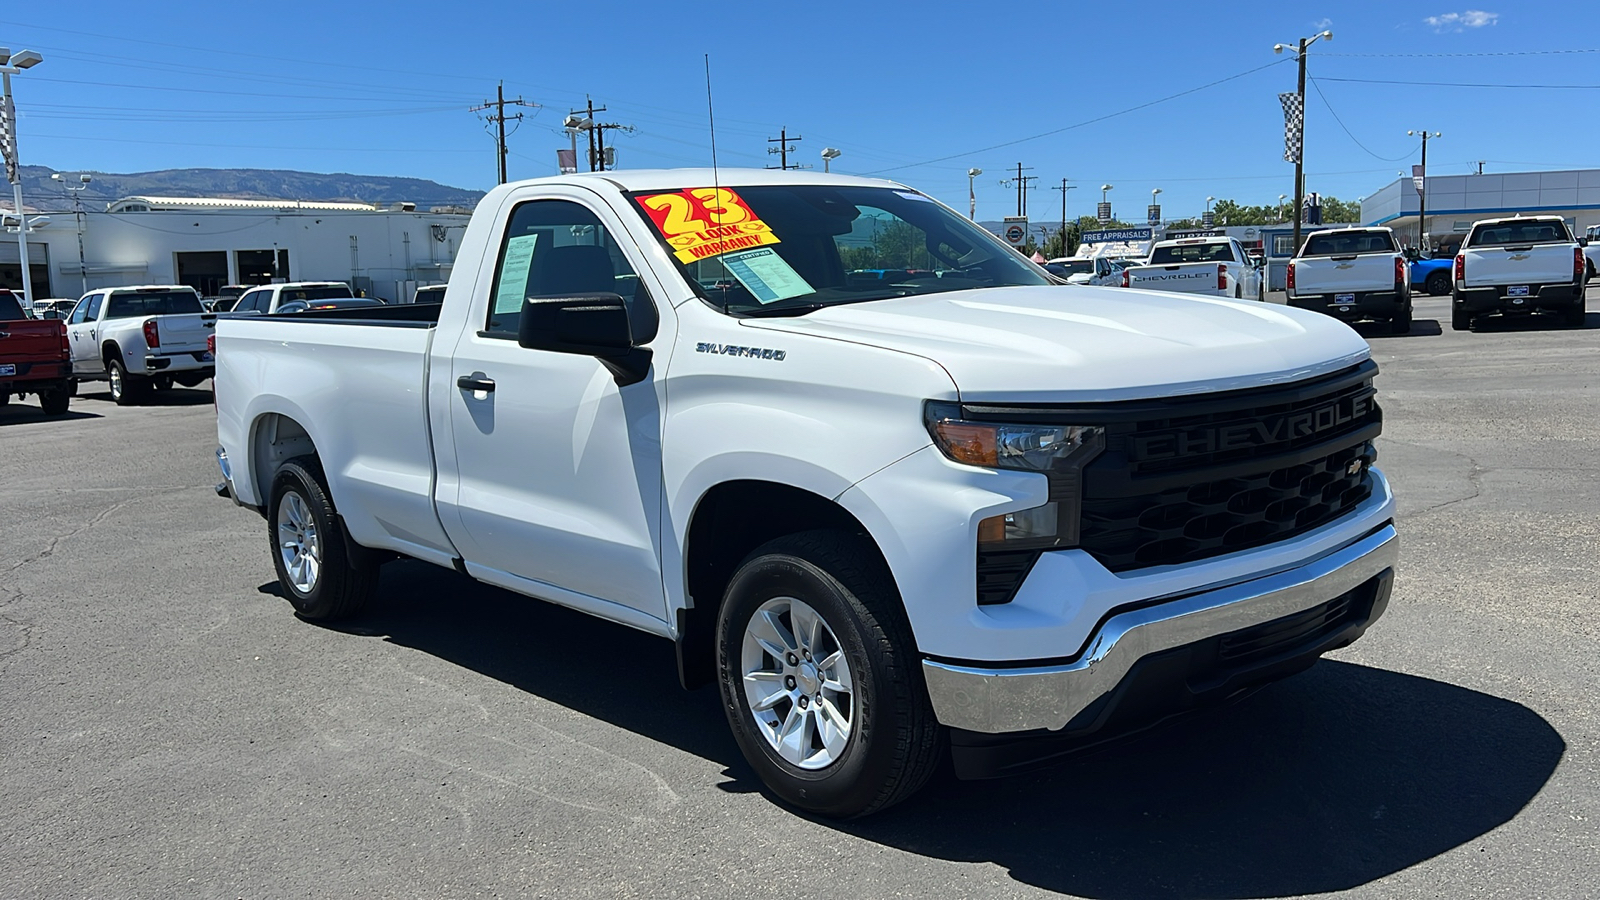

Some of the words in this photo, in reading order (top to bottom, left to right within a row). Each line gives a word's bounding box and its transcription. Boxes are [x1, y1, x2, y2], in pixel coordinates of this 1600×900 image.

[644, 188, 752, 236] 23
[695, 224, 745, 242] LOOK
[1083, 233, 1102, 242] FREE
[1102, 230, 1150, 241] APPRAISALS!
[688, 233, 763, 259] WARRANTY
[739, 250, 771, 260] CERTIFIED
[1133, 272, 1212, 283] CHEVROLET
[695, 341, 787, 362] SILVERADO
[1134, 397, 1374, 460] CHEVROLET
